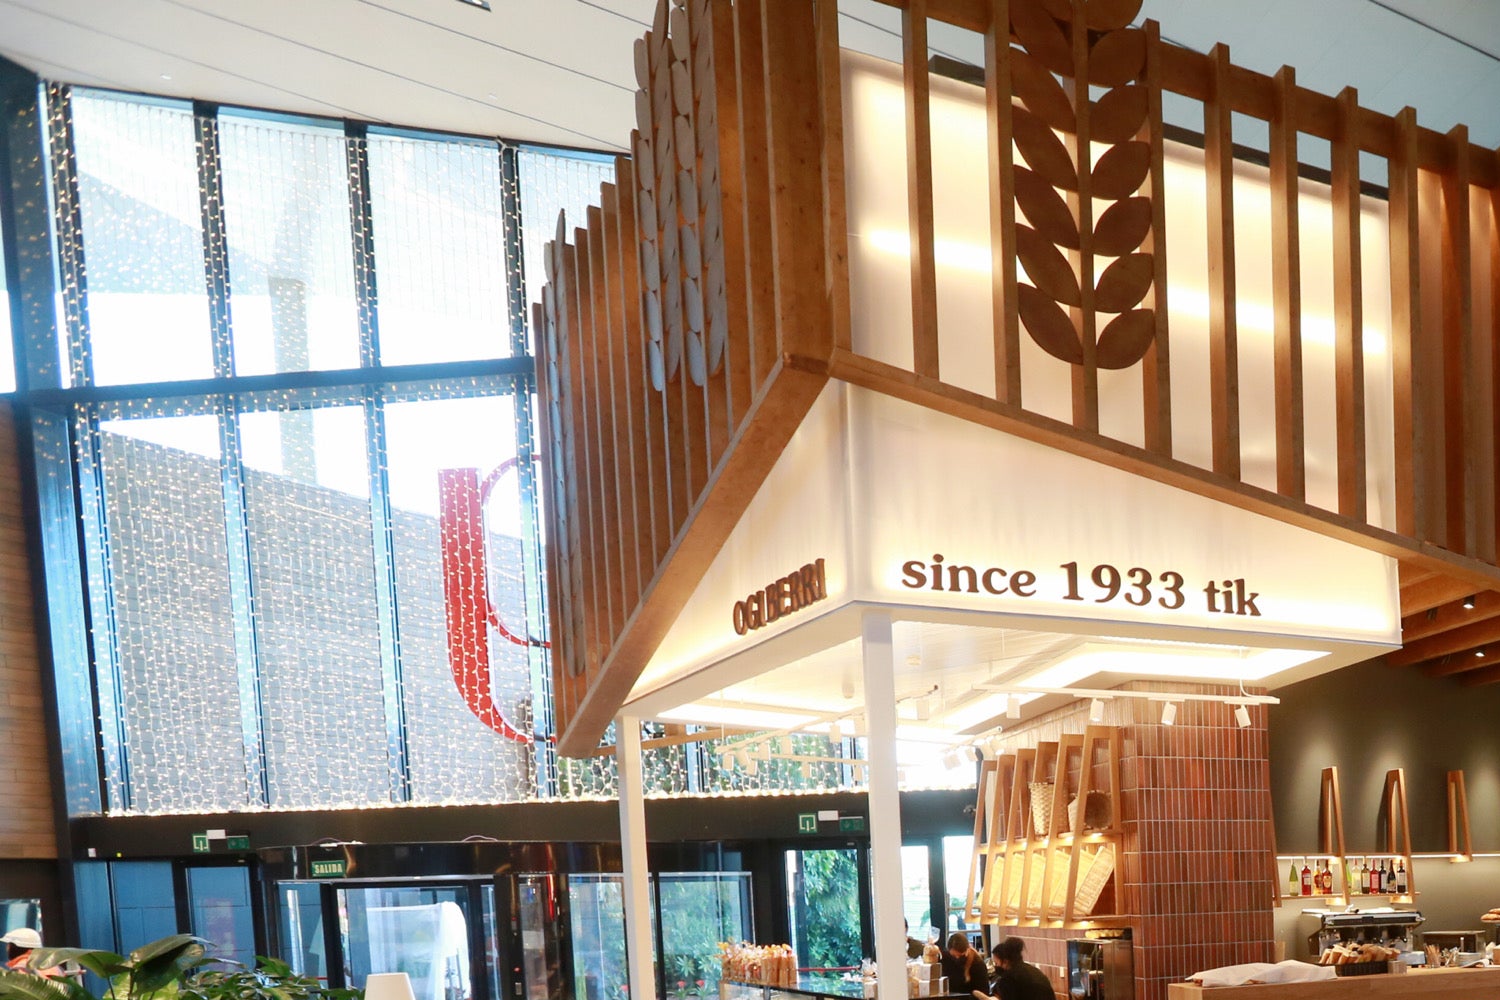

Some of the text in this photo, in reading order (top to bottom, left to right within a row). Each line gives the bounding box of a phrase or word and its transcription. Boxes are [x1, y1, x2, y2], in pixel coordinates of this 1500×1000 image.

[901, 553, 1262, 617] since 1933 tik
[314, 863, 343, 874] SALIDA
